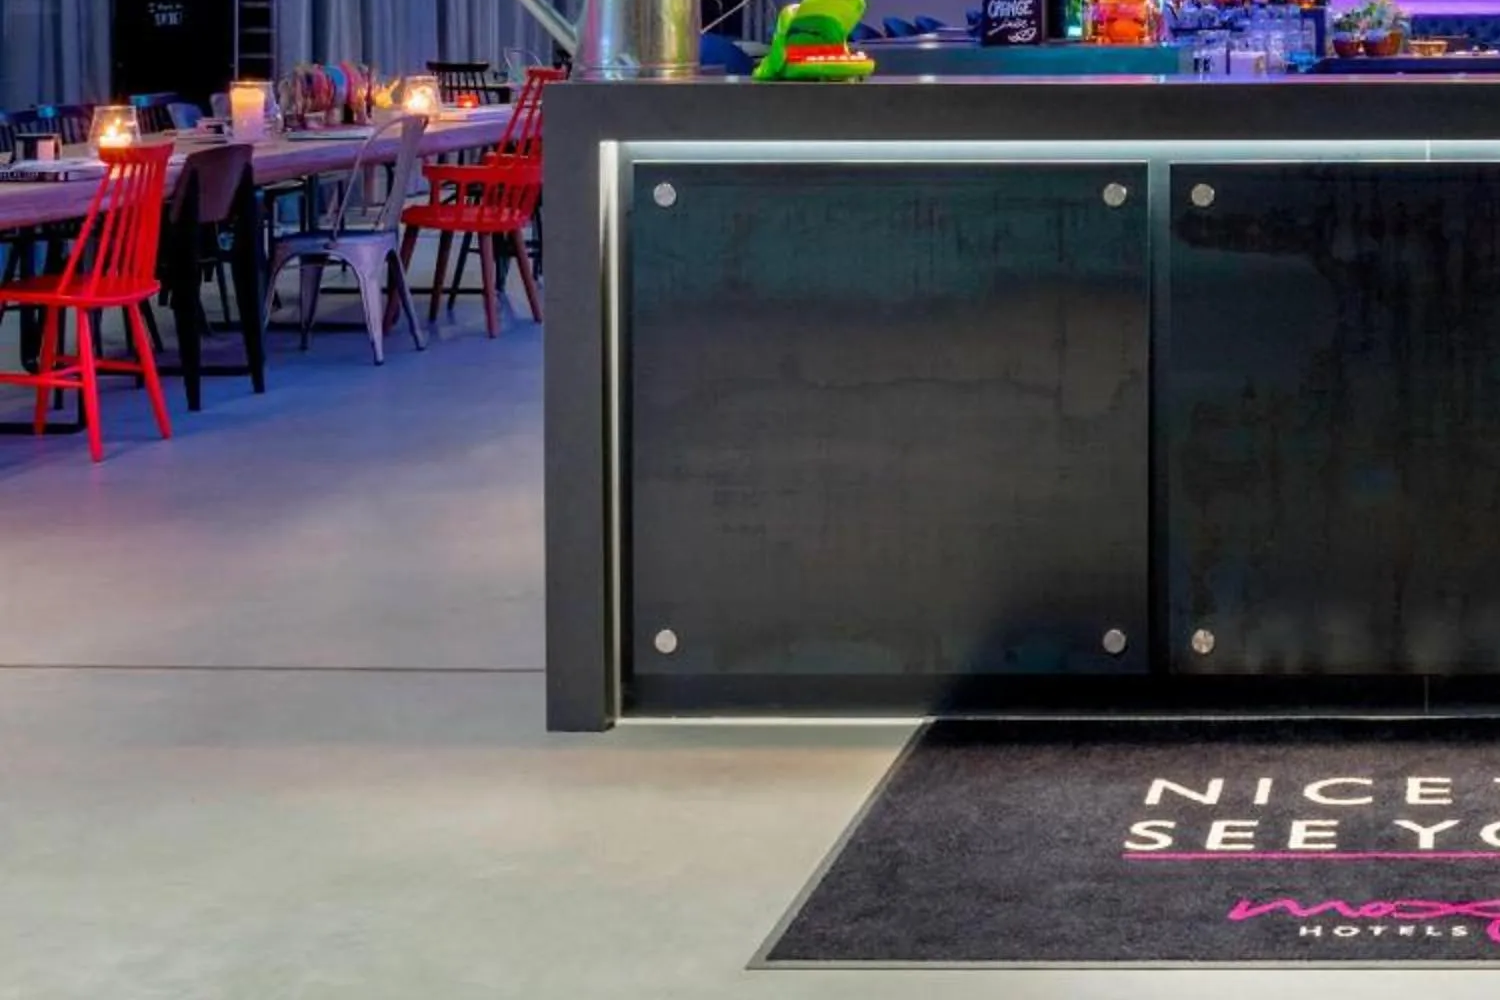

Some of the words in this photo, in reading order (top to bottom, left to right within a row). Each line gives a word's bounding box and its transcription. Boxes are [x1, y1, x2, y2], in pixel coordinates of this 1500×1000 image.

[987, 0, 1034, 18] ORANGE
[1144, 776, 1454, 805] NICE
[1124, 819, 1340, 850] SEE
[1299, 924, 1469, 938] HOTELS
